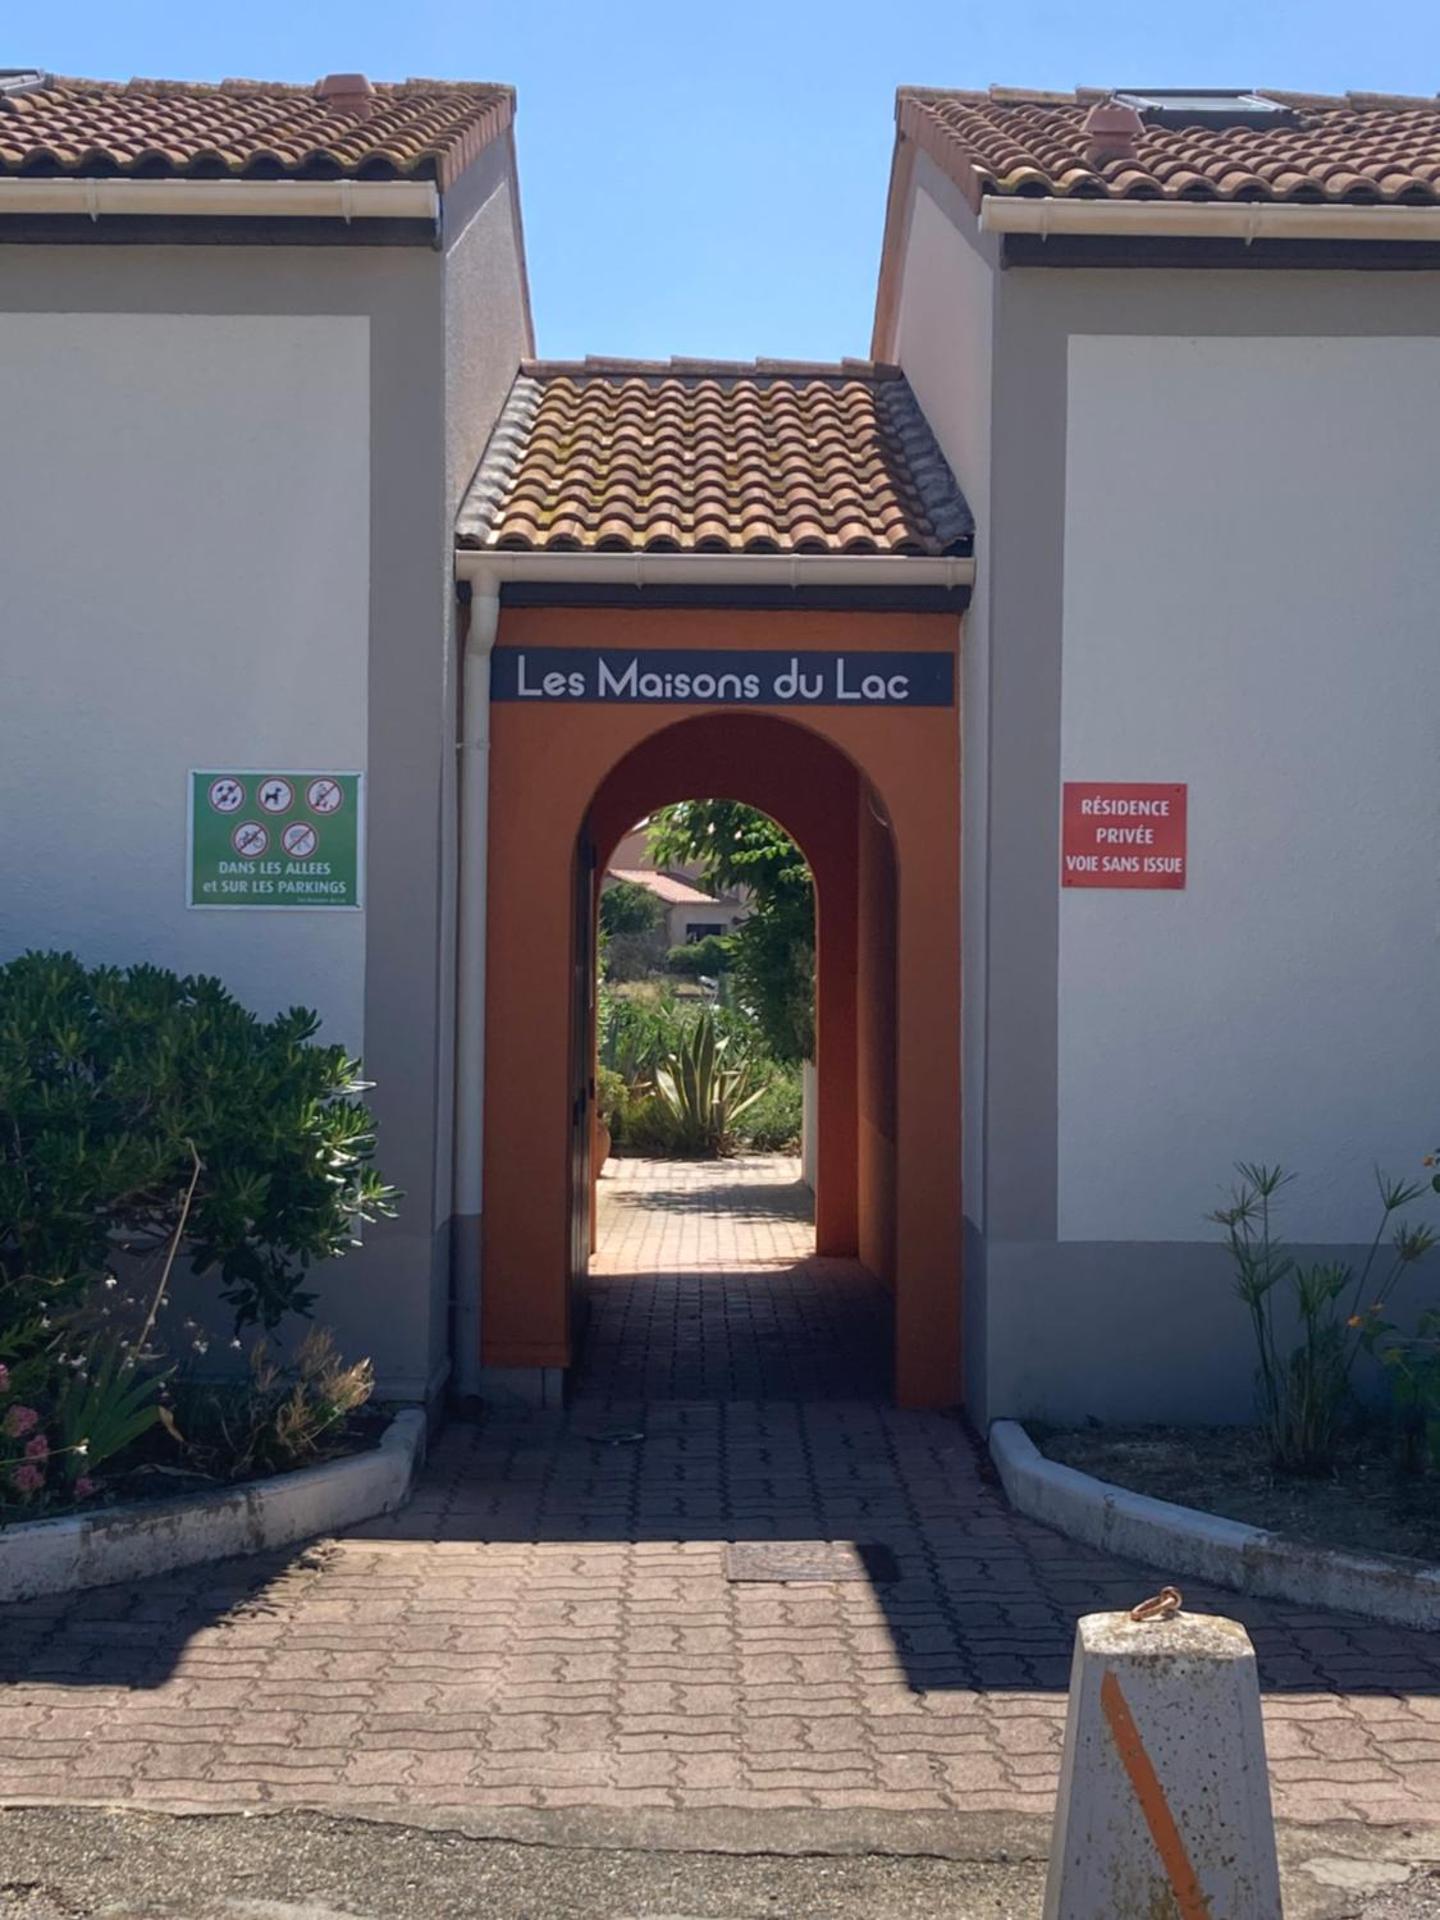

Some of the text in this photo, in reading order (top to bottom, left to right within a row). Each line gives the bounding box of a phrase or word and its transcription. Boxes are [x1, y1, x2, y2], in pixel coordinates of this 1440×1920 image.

[517, 655, 909, 700] Les Maisons du Lac
[1081, 795, 1170, 816] RÉSIDENCE
[1096, 824, 1154, 844] PRIVÉE
[219, 861, 331, 875] DANS LES ALLEES
[1066, 855, 1183, 873] VOIE SANS ISSUE
[203, 880, 346, 894] et SUR LES PARKINGS
